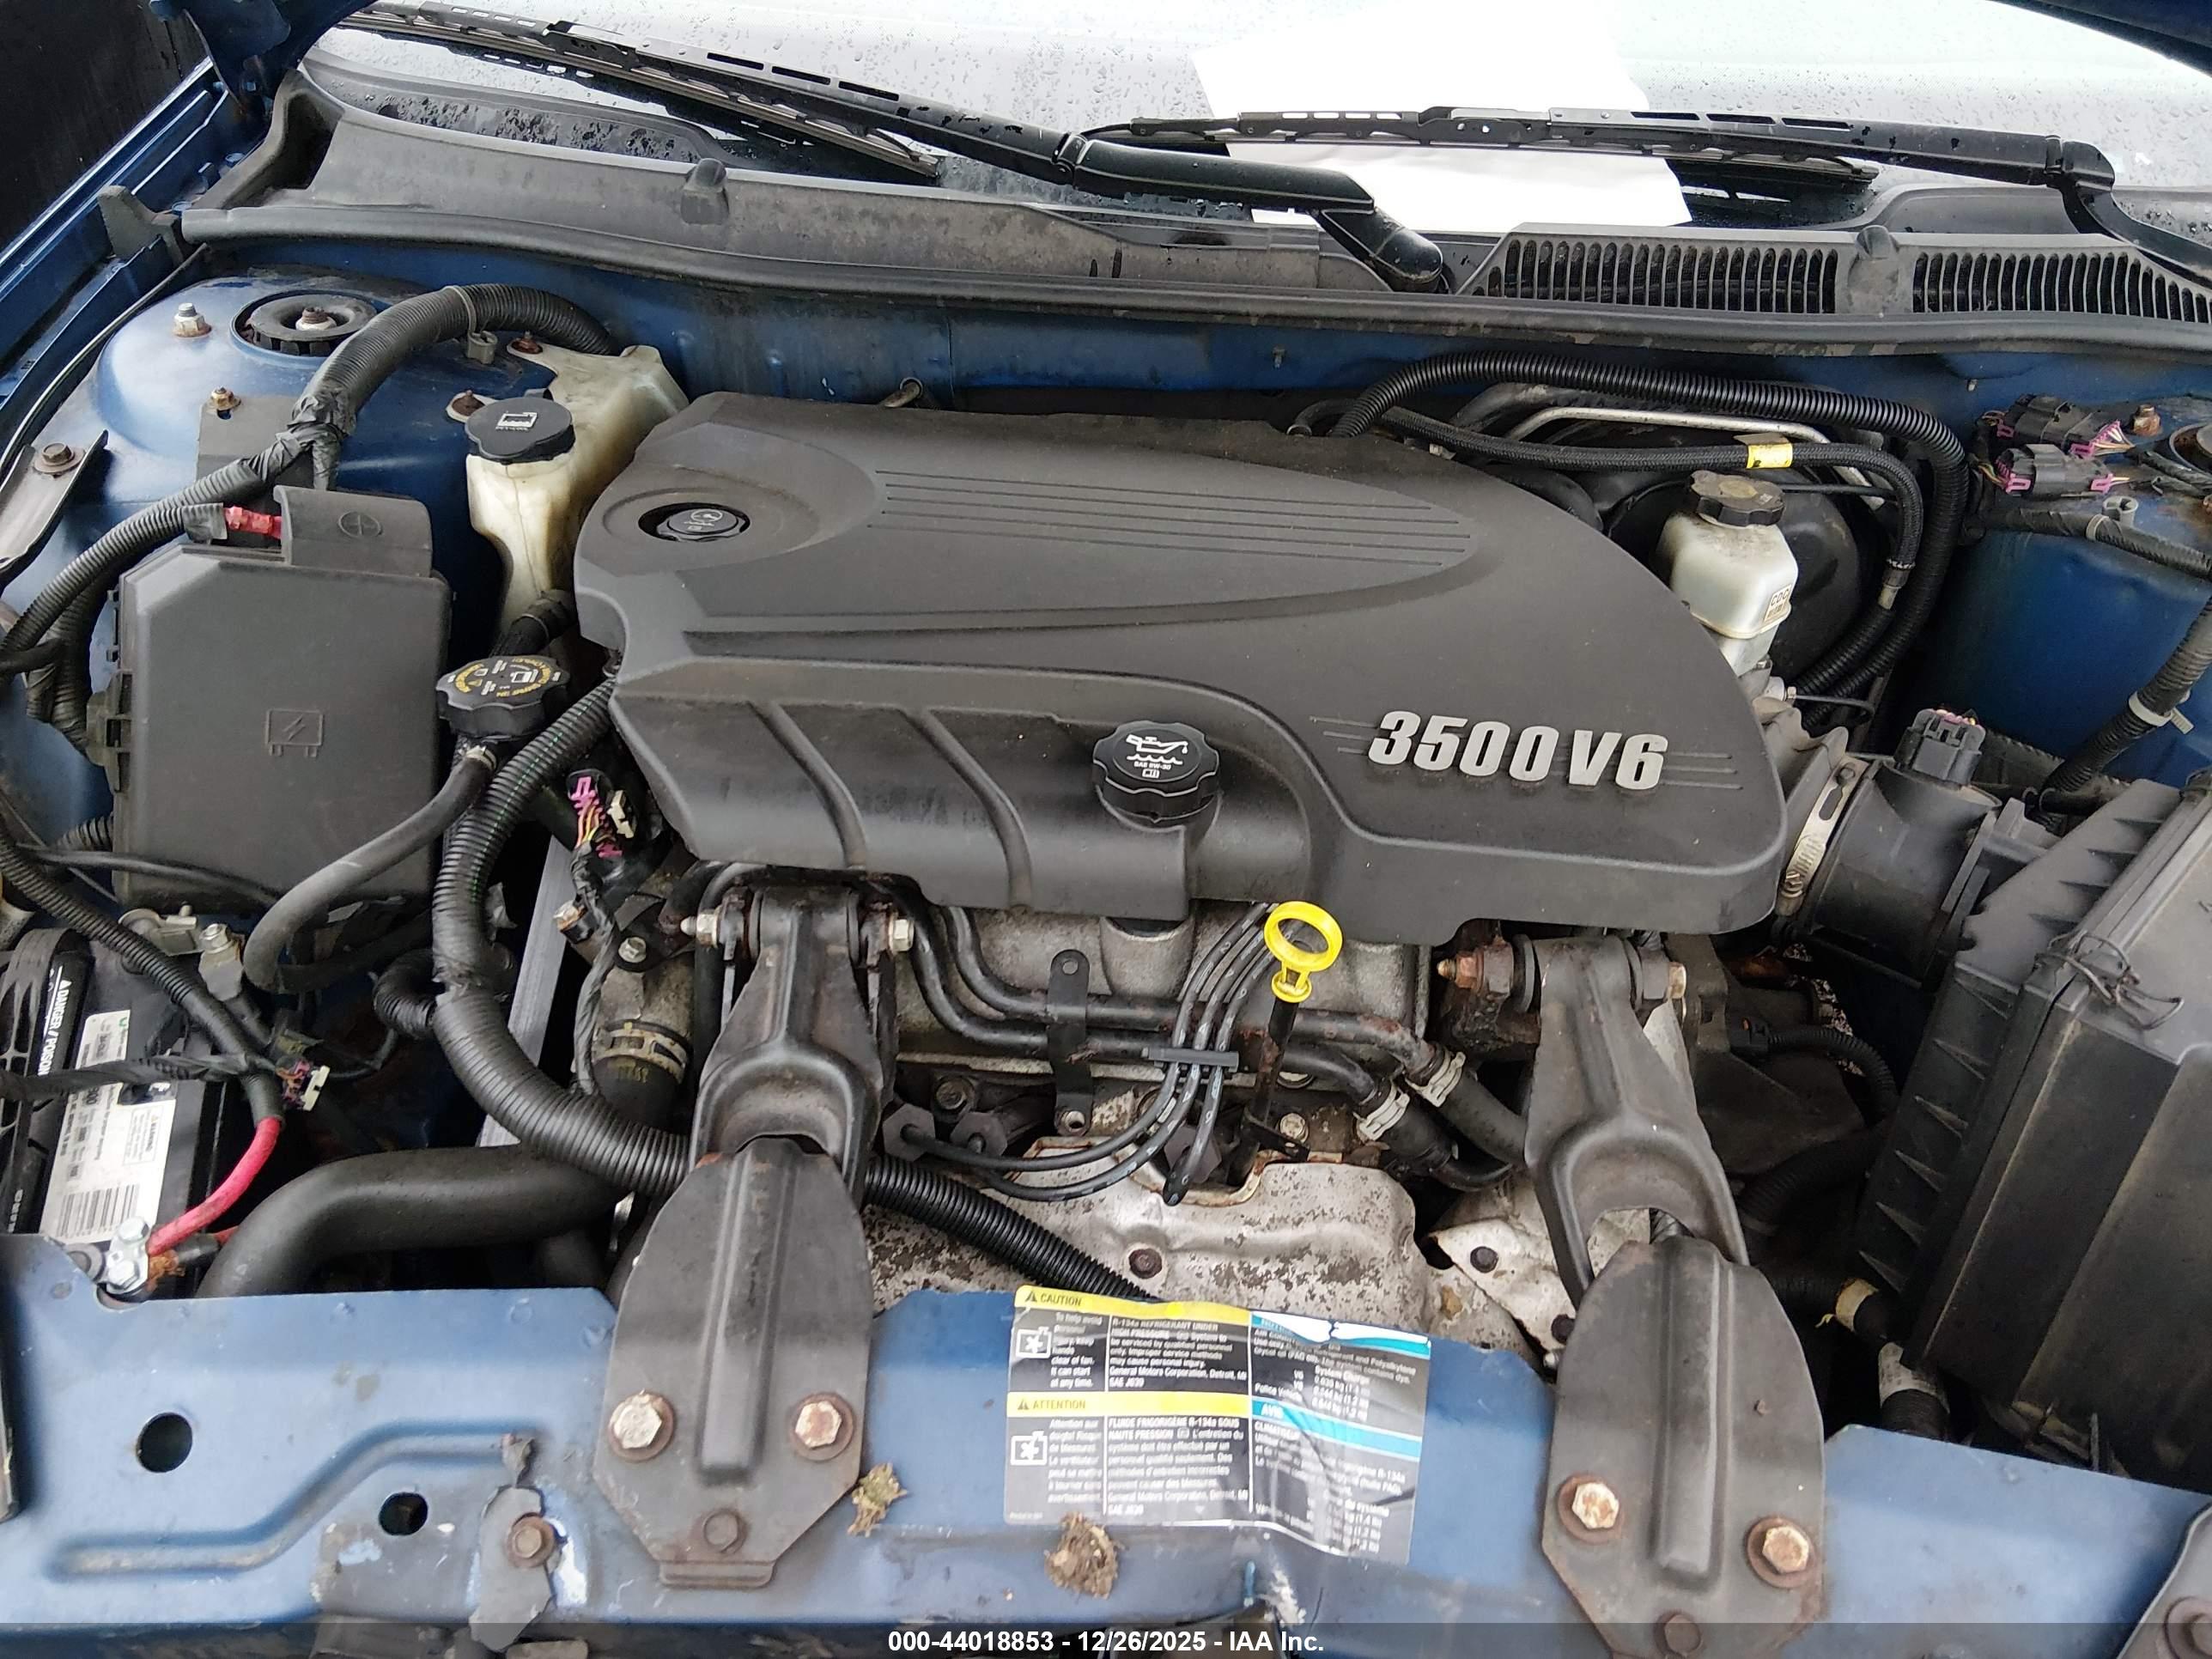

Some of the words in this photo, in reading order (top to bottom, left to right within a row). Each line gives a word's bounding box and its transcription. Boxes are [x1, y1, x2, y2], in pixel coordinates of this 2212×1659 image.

[1368, 710, 1559, 781] 3500
[1568, 729, 1668, 790] V6
[49, 988, 69, 1030] DANGER
[37, 1037, 58, 1077] POISON
[1040, 1293, 1083, 1306] CAUTION
[1112, 1318, 1139, 1328] R-134a
[1192, 1322, 1218, 1332] UNDER
[1121, 1339, 1152, 1348] serviced
[1127, 1358, 1149, 1366] cause
[1150, 1358, 1182, 1367] personal
[1109, 1366, 1138, 1376] General
[1138, 1366, 1164, 1376] Motors
[1164, 1367, 1208, 1378] Corporation,
[1060, 1378, 1073, 1389] any
[1032, 1399, 1086, 1409] ATTENTION
[1109, 1417, 1135, 1428] FLUIDE
[1188, 1417, 1217, 1427] R-134a
[1109, 1430, 1134, 1440] HAUTE
[1134, 1429, 1174, 1440] PRESSION
